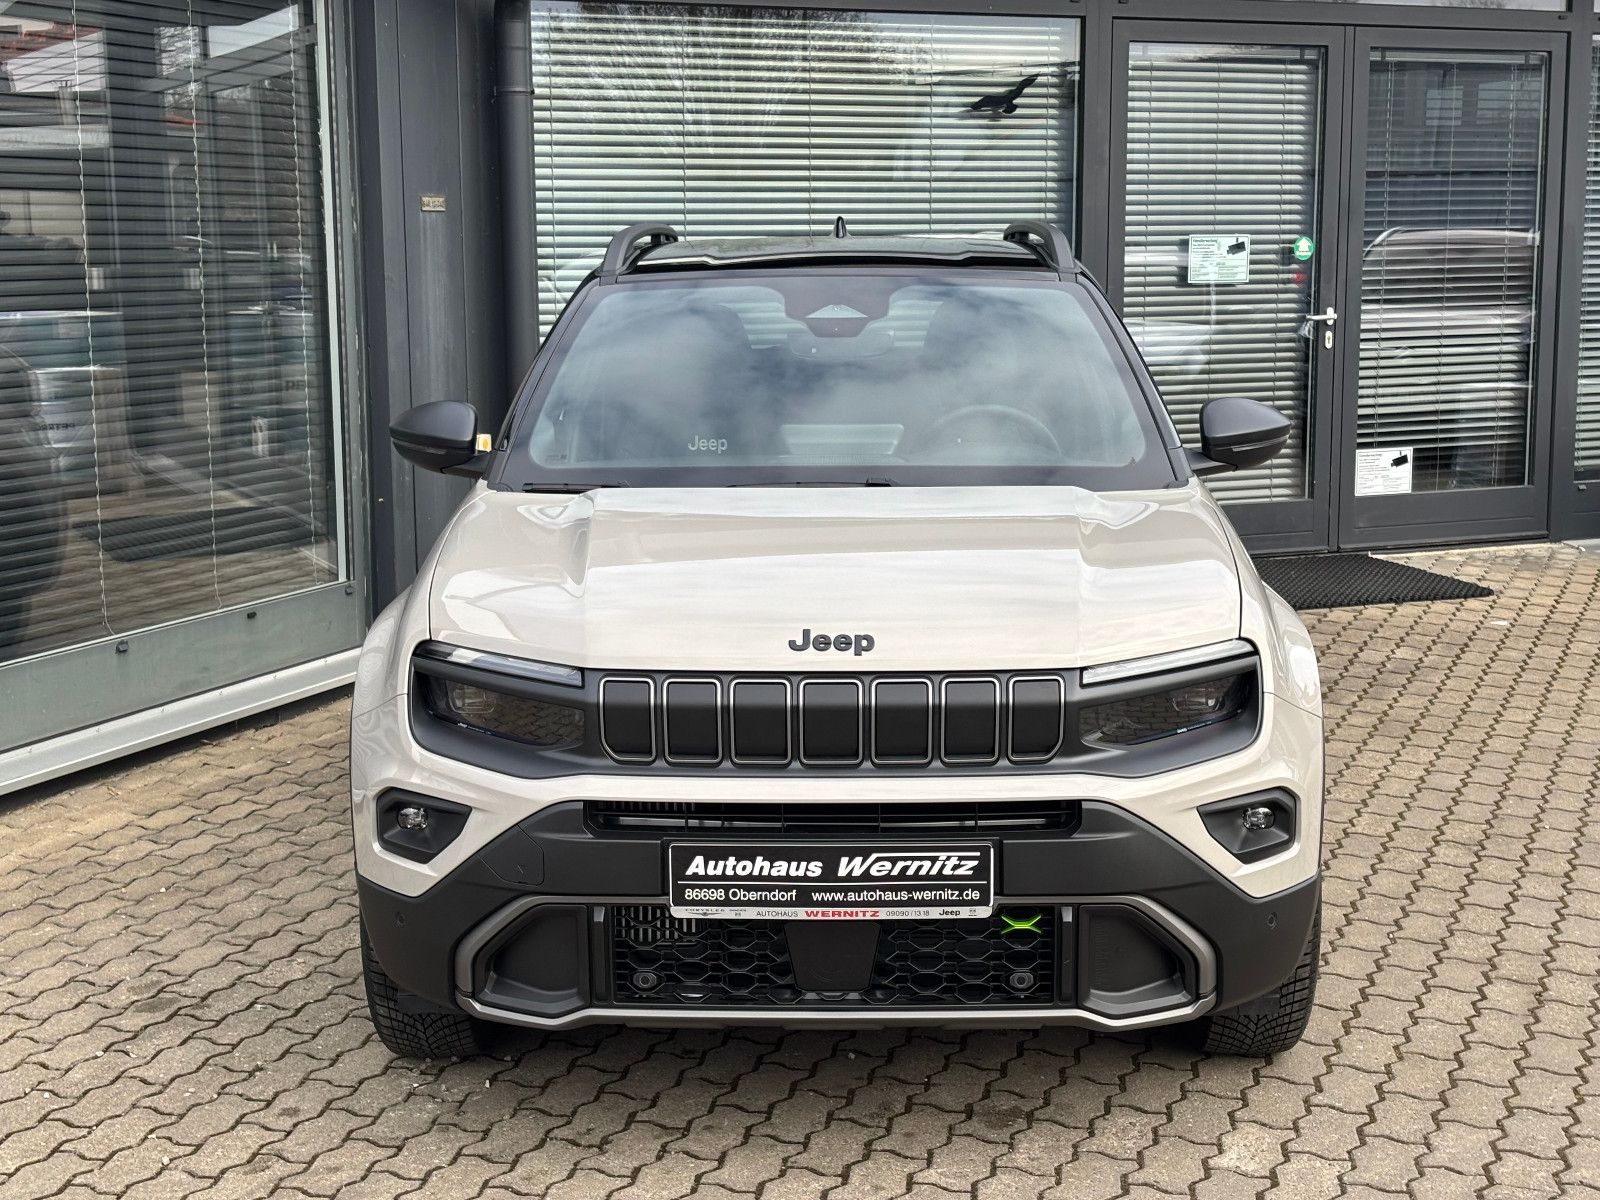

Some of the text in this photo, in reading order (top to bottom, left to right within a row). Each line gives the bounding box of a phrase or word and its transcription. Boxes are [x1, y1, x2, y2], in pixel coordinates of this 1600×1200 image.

[687, 434, 728, 454] Jeep
[788, 628, 875, 656] Jeep
[685, 852, 980, 877] Autohaus Wernitz
[684, 888, 980, 901] 86698 Oberndorf www.autohaus-wernitz.de
[804, 910, 880, 918] WERNITZ
[939, 909, 961, 917] Jeep
